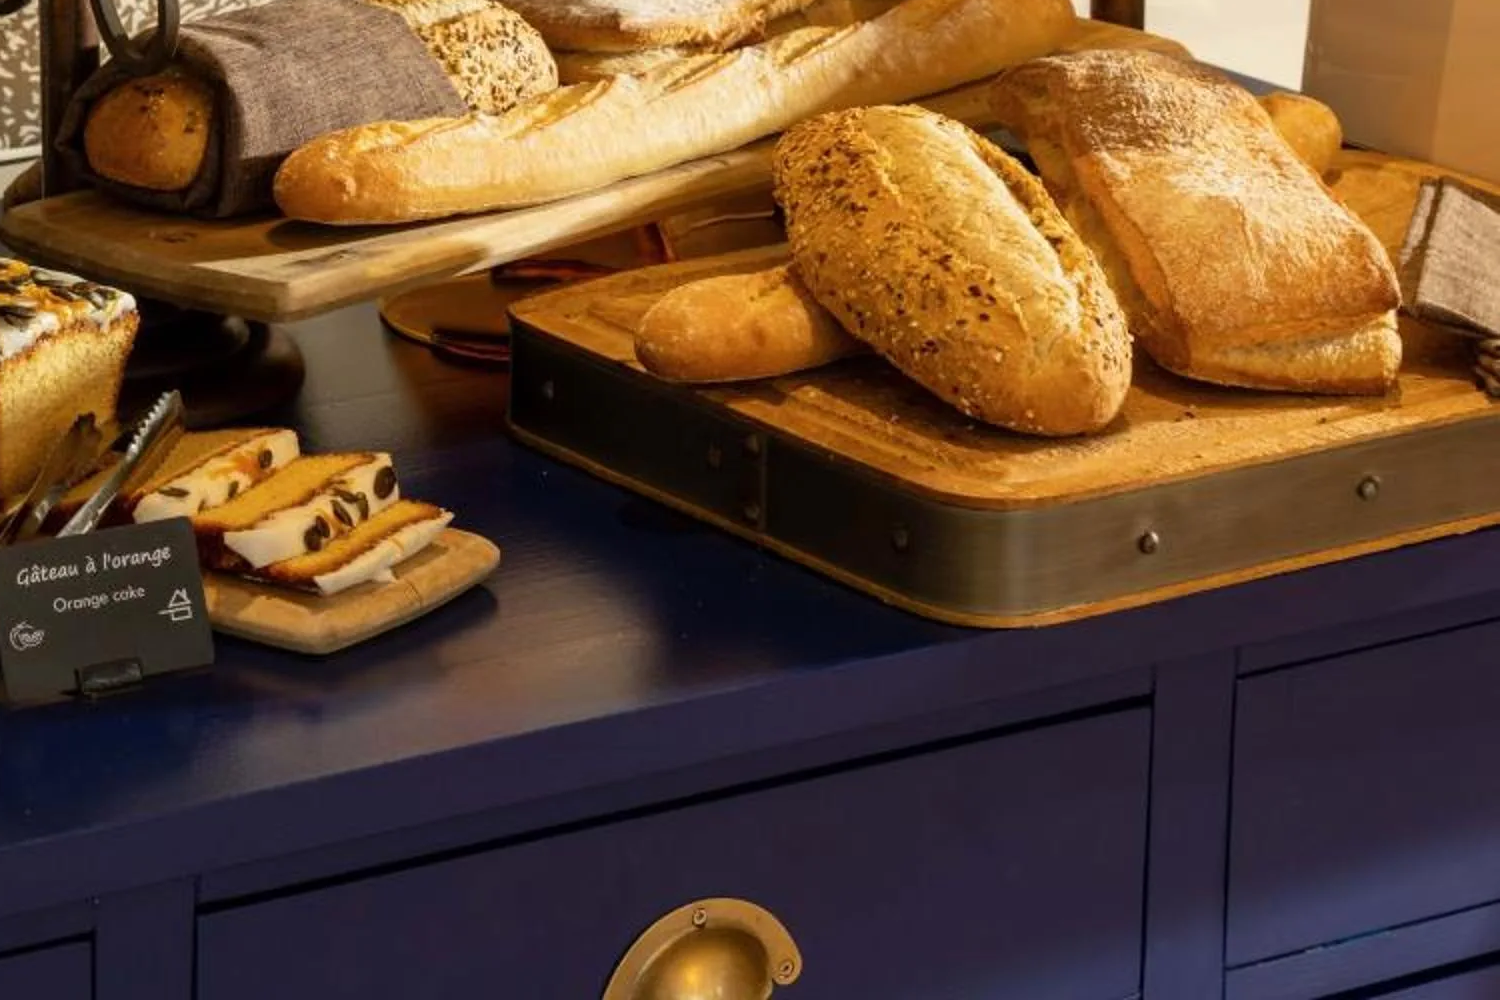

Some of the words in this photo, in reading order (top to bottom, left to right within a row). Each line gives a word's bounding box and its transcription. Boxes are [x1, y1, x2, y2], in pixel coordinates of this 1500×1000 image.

[17, 563, 78, 587] Gâteau
[85, 556, 96, 574] à
[103, 546, 171, 571] l'orange
[53, 593, 110, 612] Orange
[112, 585, 145, 602] cake
